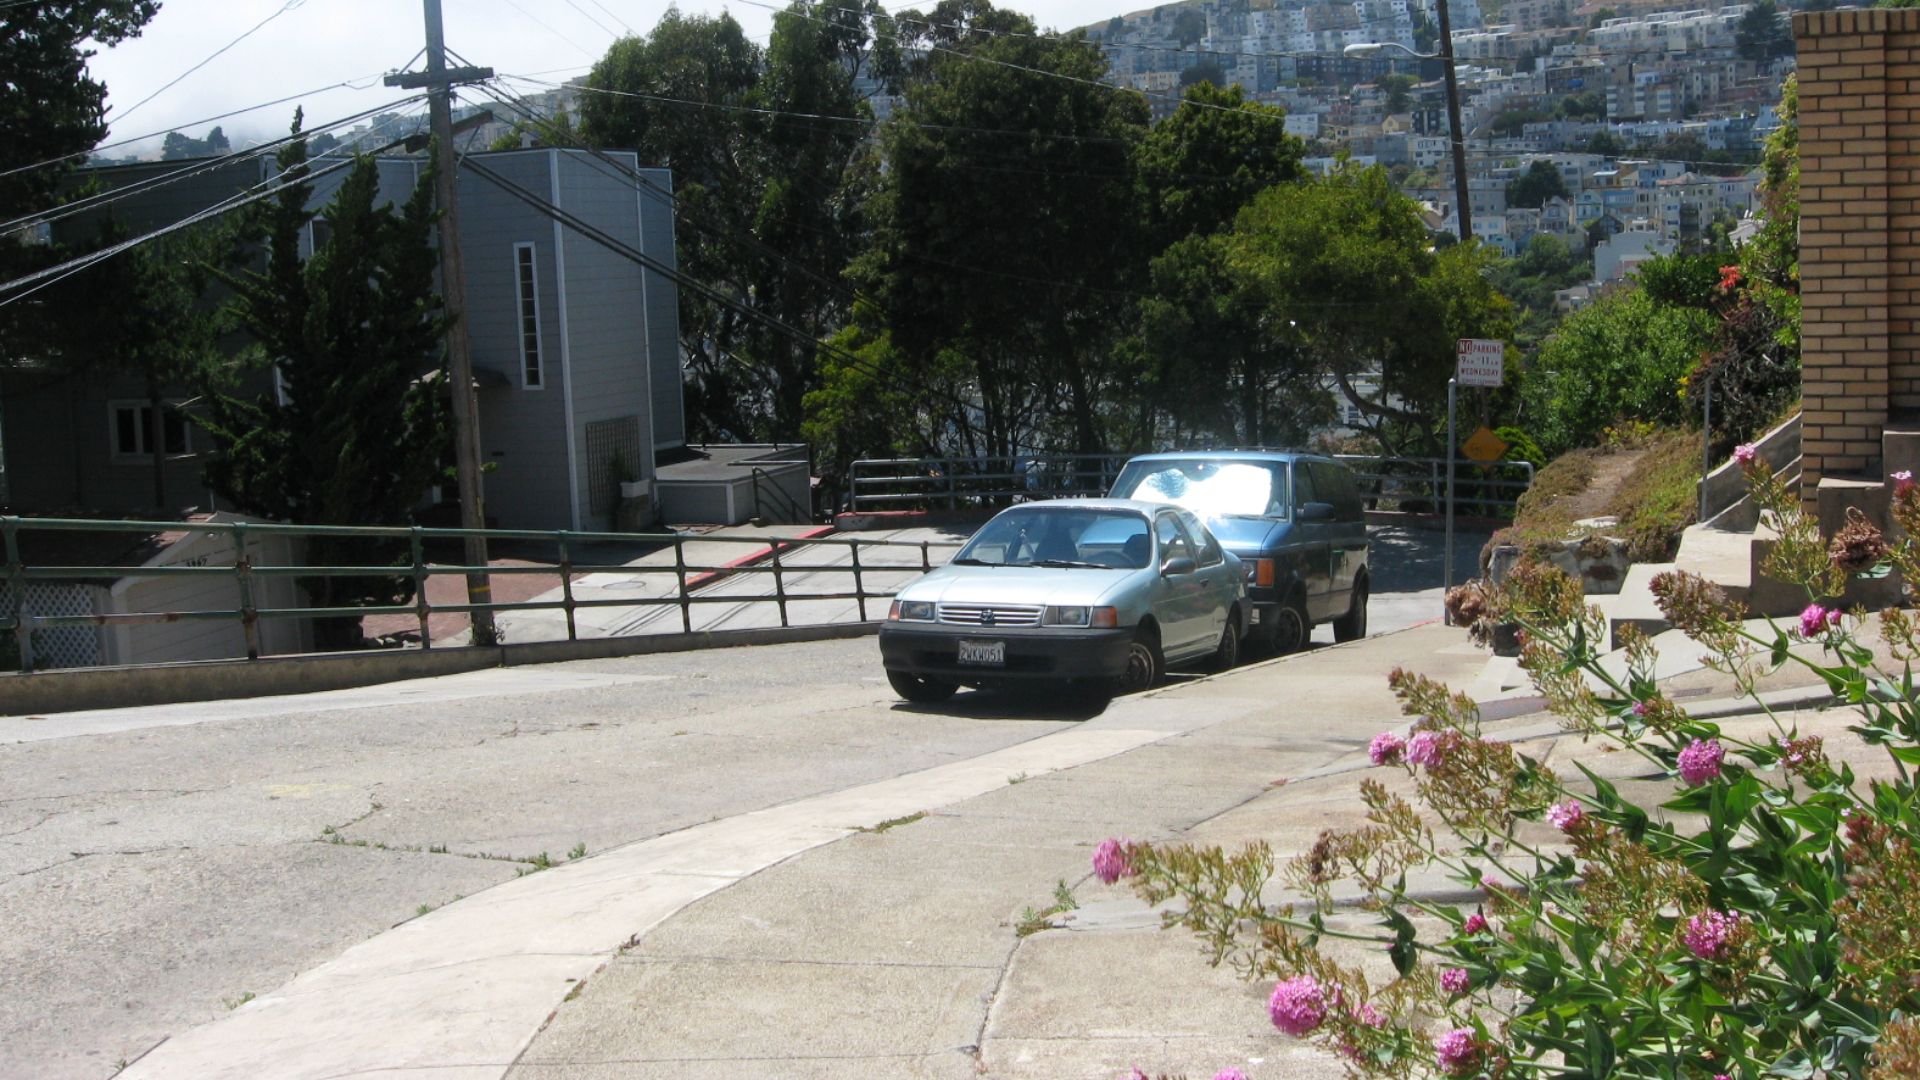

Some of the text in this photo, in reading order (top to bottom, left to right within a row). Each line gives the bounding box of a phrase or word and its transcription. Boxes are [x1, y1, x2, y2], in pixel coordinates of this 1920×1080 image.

[1458, 340, 1500, 353] NO PARKING
[1461, 367, 1498, 377] WEDNESDAY
